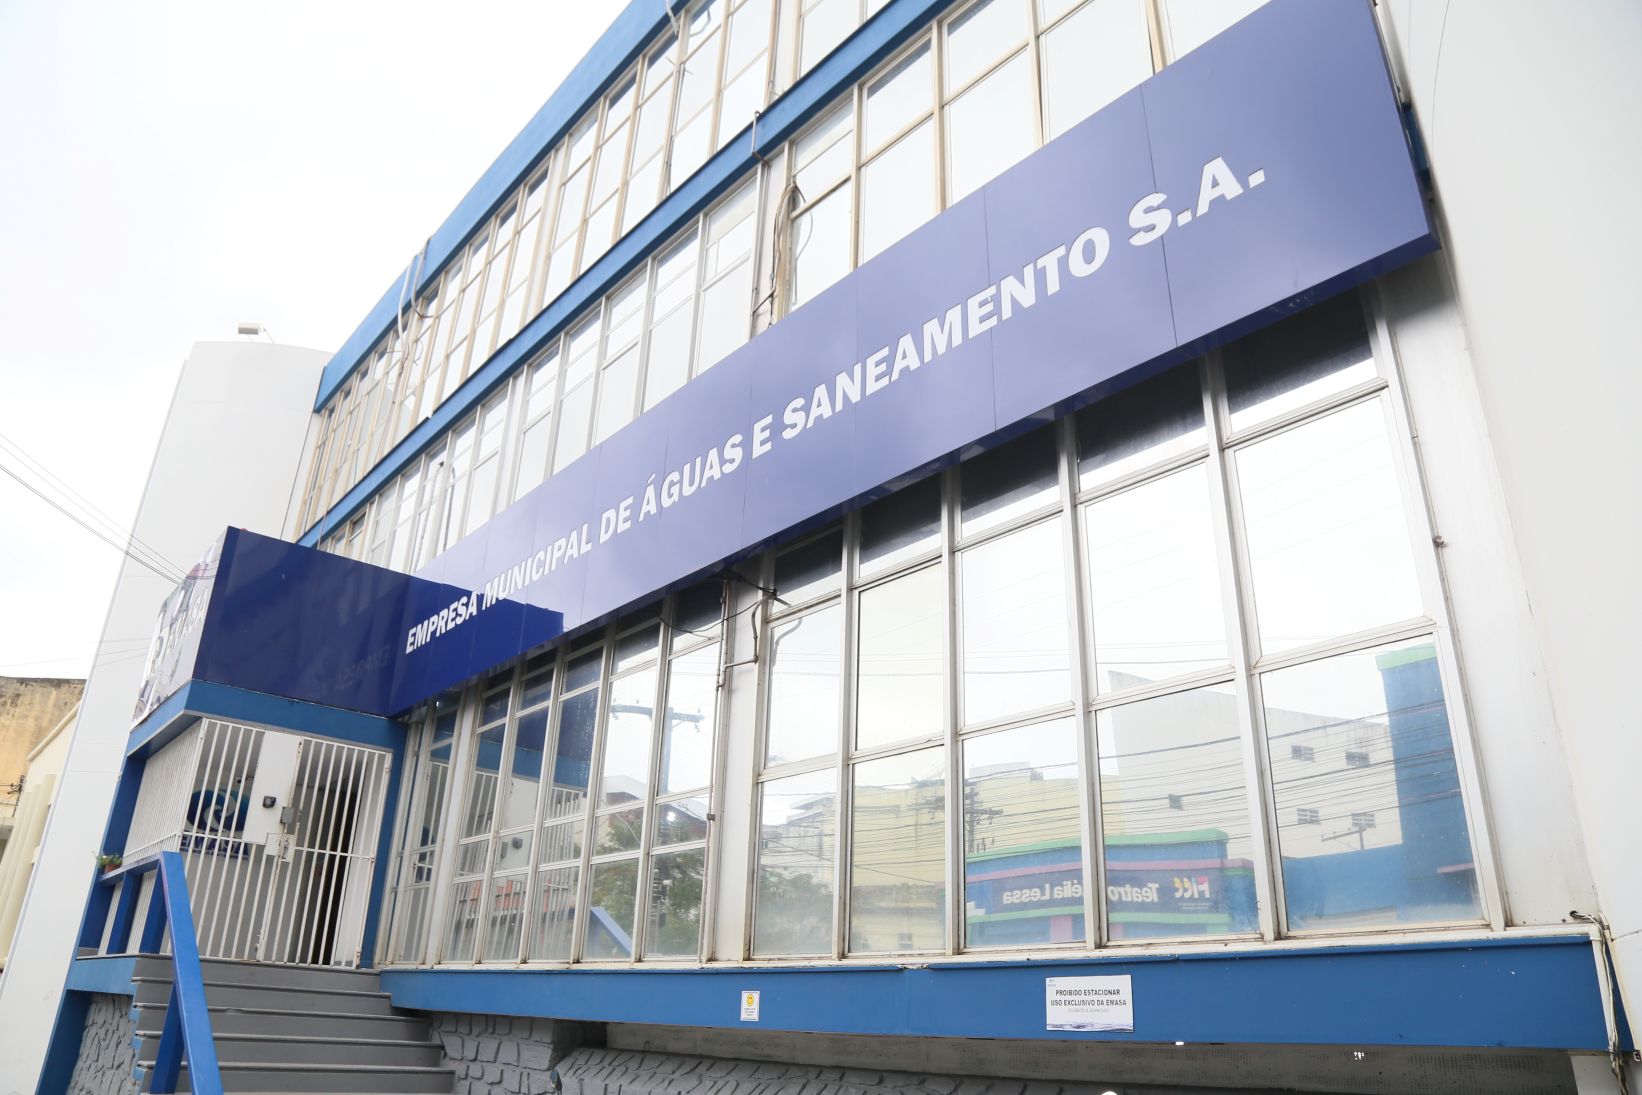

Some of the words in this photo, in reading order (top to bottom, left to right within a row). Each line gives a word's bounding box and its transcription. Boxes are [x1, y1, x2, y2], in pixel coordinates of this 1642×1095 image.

[406, 591, 477, 655] EMPRESA
[482, 523, 592, 610] MUNICIPAL
[600, 496, 633, 544] DE
[638, 433, 743, 522] ÁGUAS
[752, 414, 773, 459] E
[782, 227, 1110, 440] SANEAMENTO
[1128, 156, 1265, 246] S.A.
